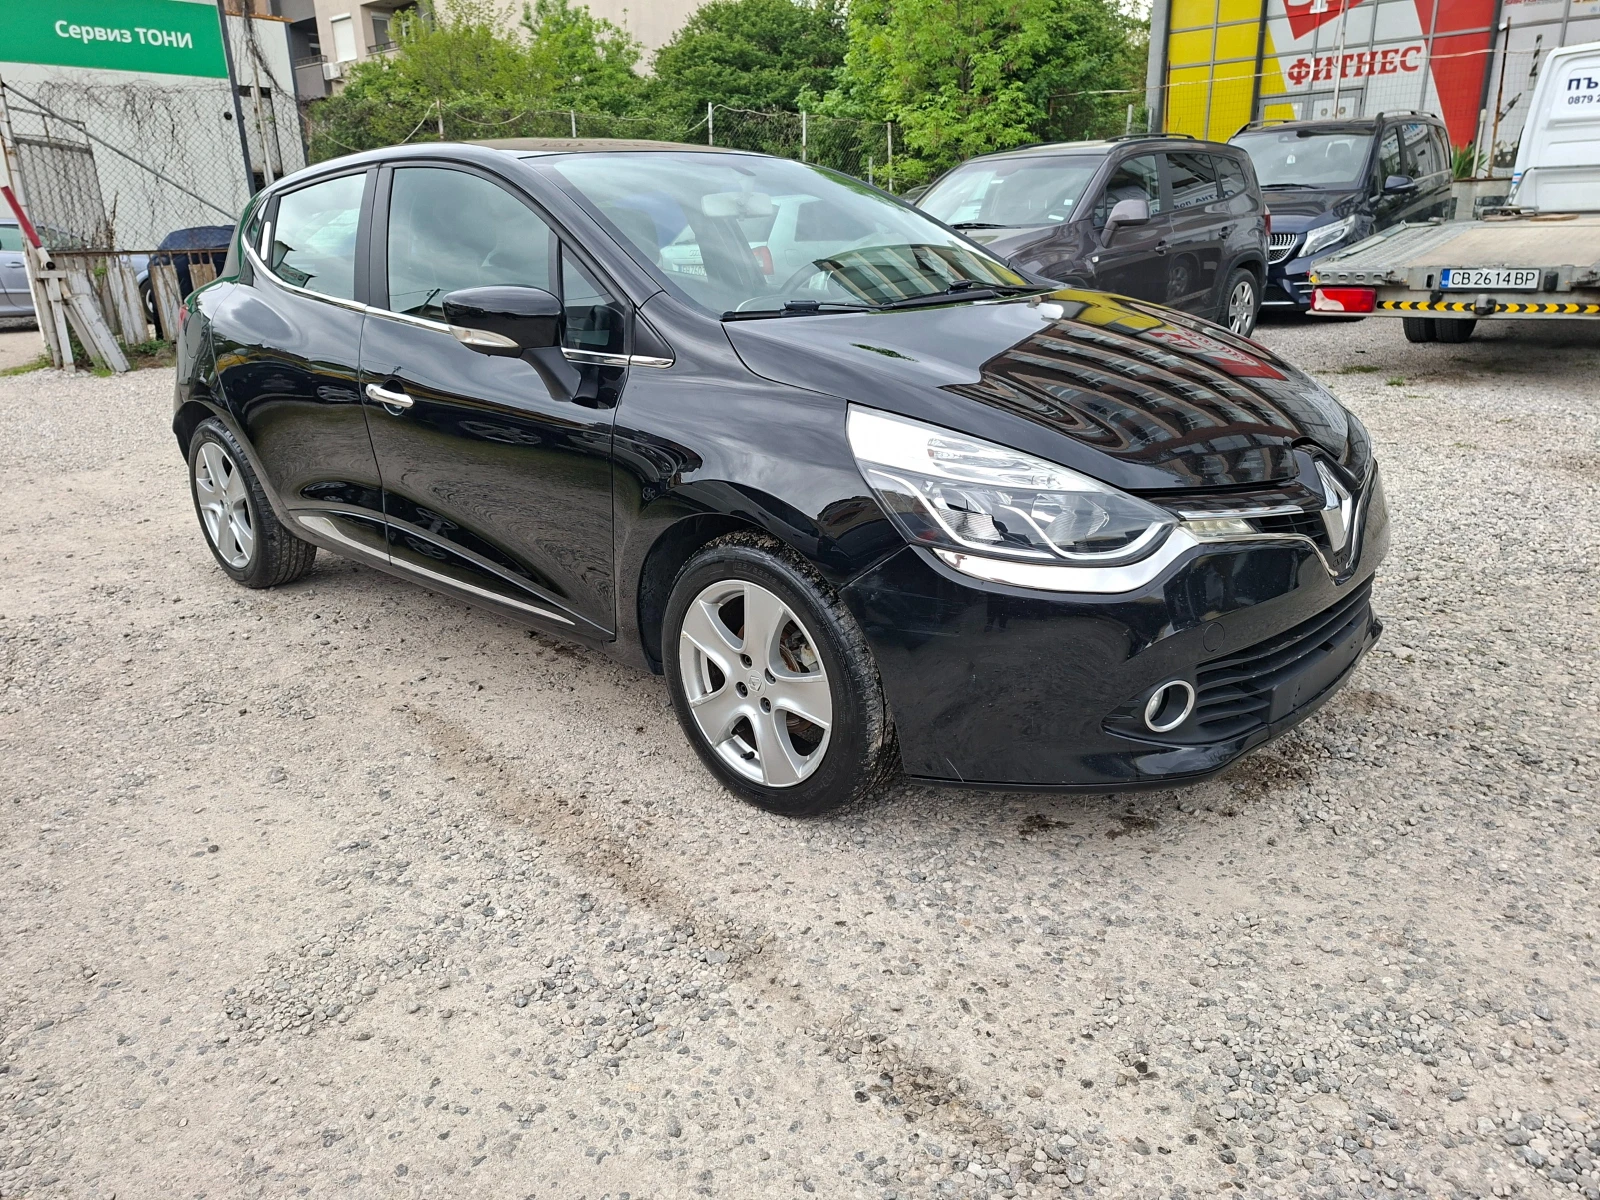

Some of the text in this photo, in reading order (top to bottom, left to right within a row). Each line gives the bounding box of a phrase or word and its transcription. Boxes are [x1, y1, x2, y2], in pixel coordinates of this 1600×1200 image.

[54, 20, 193, 49] Сервиз ТОНИ
[1287, 46, 1422, 86] ФИТНЕС
[1568, 95, 1593, 105] 0879
